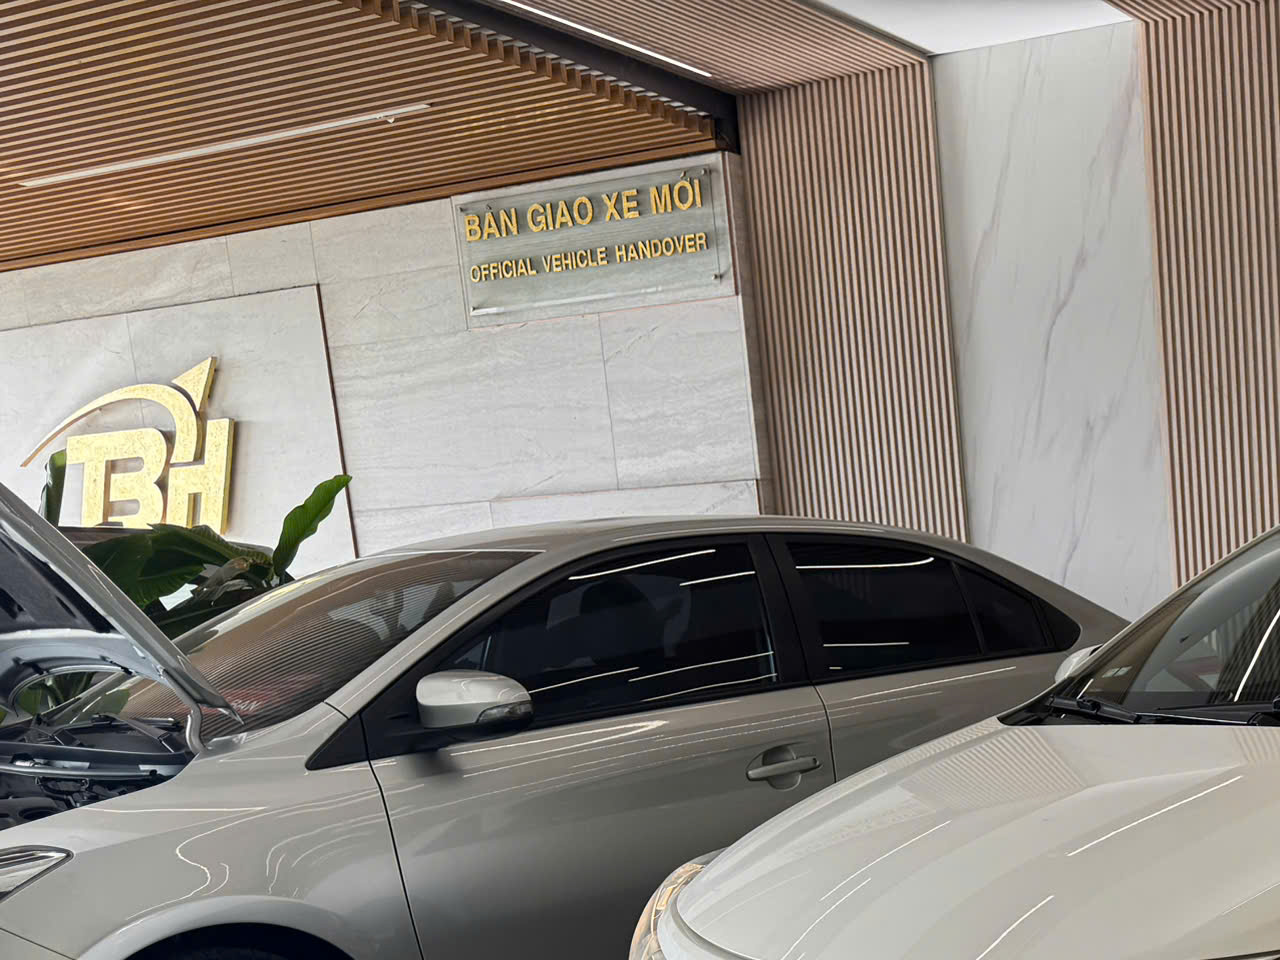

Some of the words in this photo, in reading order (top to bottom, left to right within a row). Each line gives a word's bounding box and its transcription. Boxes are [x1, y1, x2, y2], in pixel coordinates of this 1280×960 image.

[527, 195, 594, 233] GIAO
[601, 189, 642, 222] XE
[470, 257, 537, 283] OFFICIAL
[542, 247, 609, 274] VEHICLE
[615, 232, 709, 264] HANDOVER
